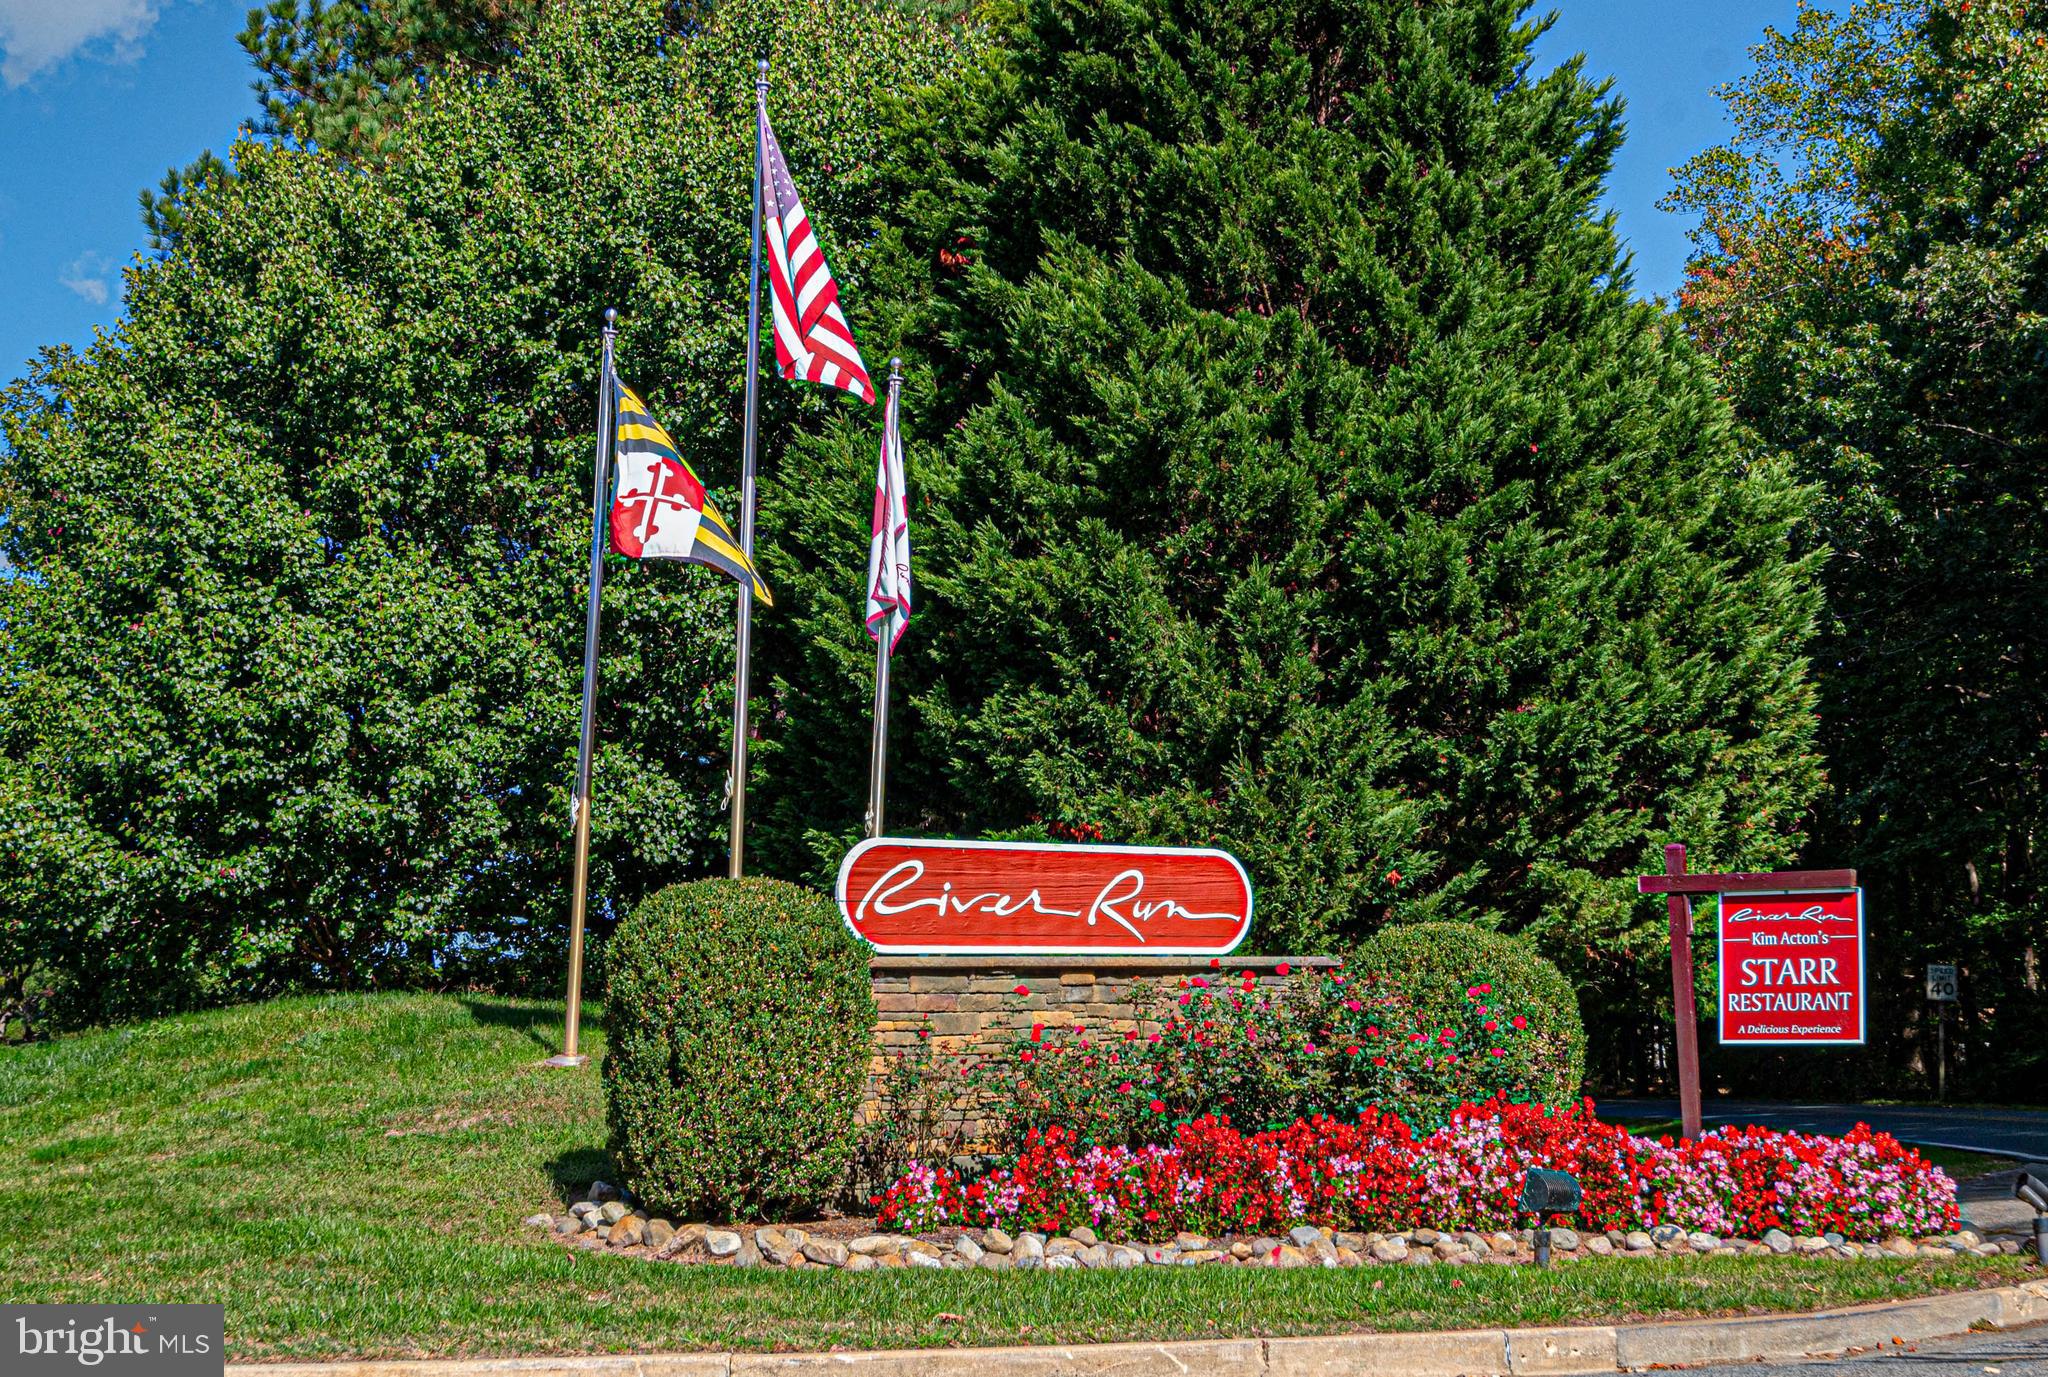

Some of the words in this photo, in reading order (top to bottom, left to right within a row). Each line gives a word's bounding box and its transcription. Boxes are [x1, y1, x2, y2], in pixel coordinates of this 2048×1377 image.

[855, 859, 1081, 921] River
[1087, 869, 1242, 943] Run
[1728, 907, 1800, 923] River
[1799, 905, 1854, 924] Run
[1752, 931, 1778, 945] Kim
[1780, 930, 1829, 945] Acton's
[1741, 957, 1841, 986] STARR
[1930, 982, 1954, 996] 40
[1728, 991, 1853, 1012] RESTAURANT
[1738, 1025, 1746, 1034] A
[1747, 1024, 1790, 1034] Delicious
[1791, 1024, 1842, 1036] Experience
